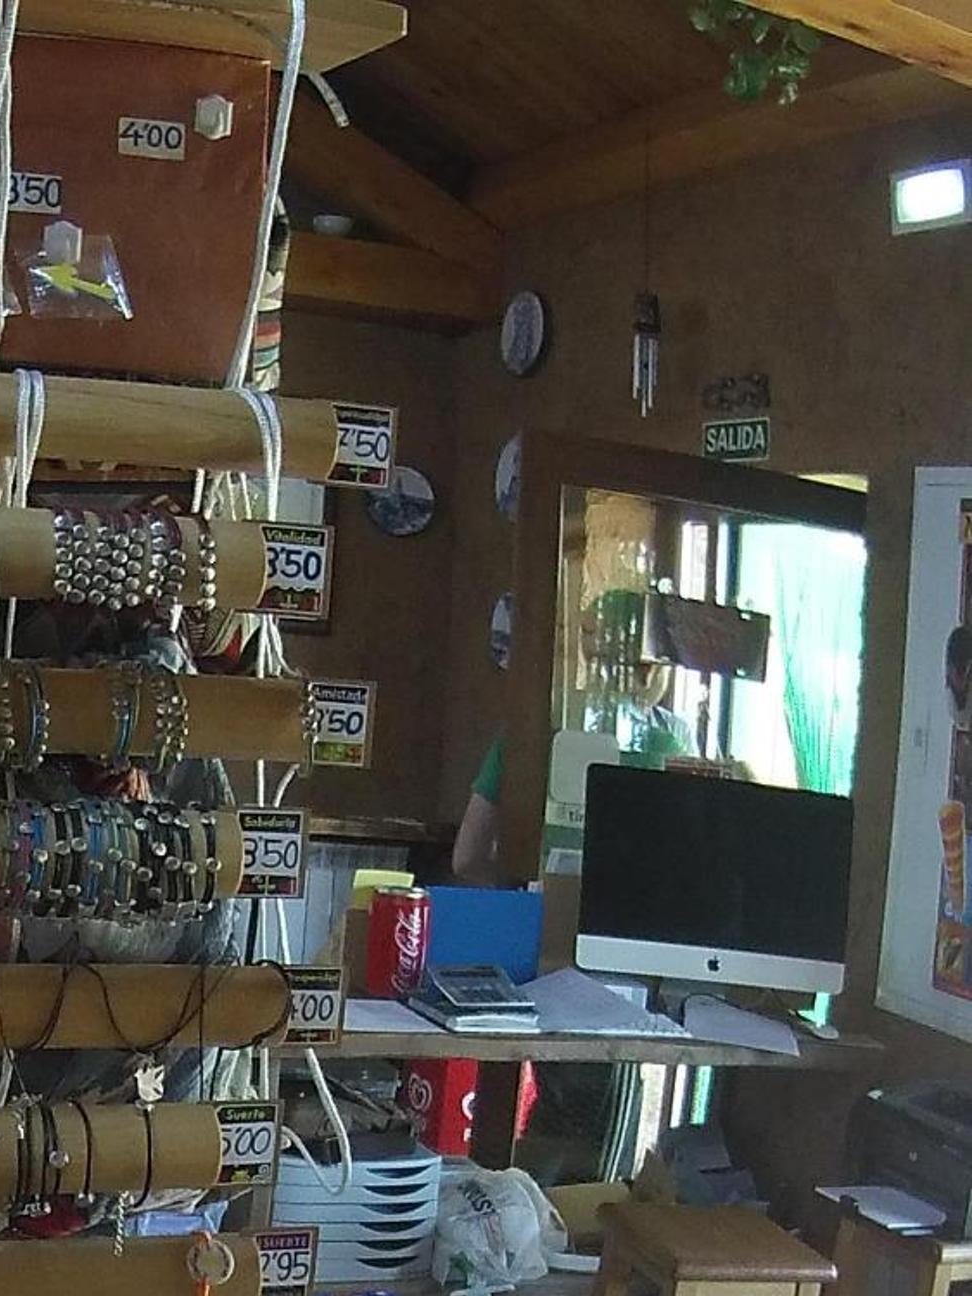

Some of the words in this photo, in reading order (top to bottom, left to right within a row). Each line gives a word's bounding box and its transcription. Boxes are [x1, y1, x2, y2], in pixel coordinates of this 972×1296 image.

[120, 120, 184, 150] 4'00
[706, 426, 766, 454] SALIDA
[266, 529, 322, 546] Vitalidad
[267, 546, 322, 581] 3'50
[243, 835, 299, 869] 3'50
[225, 1108, 267, 1121] Suerte
[261, 1250, 309, 1283] 2'95
